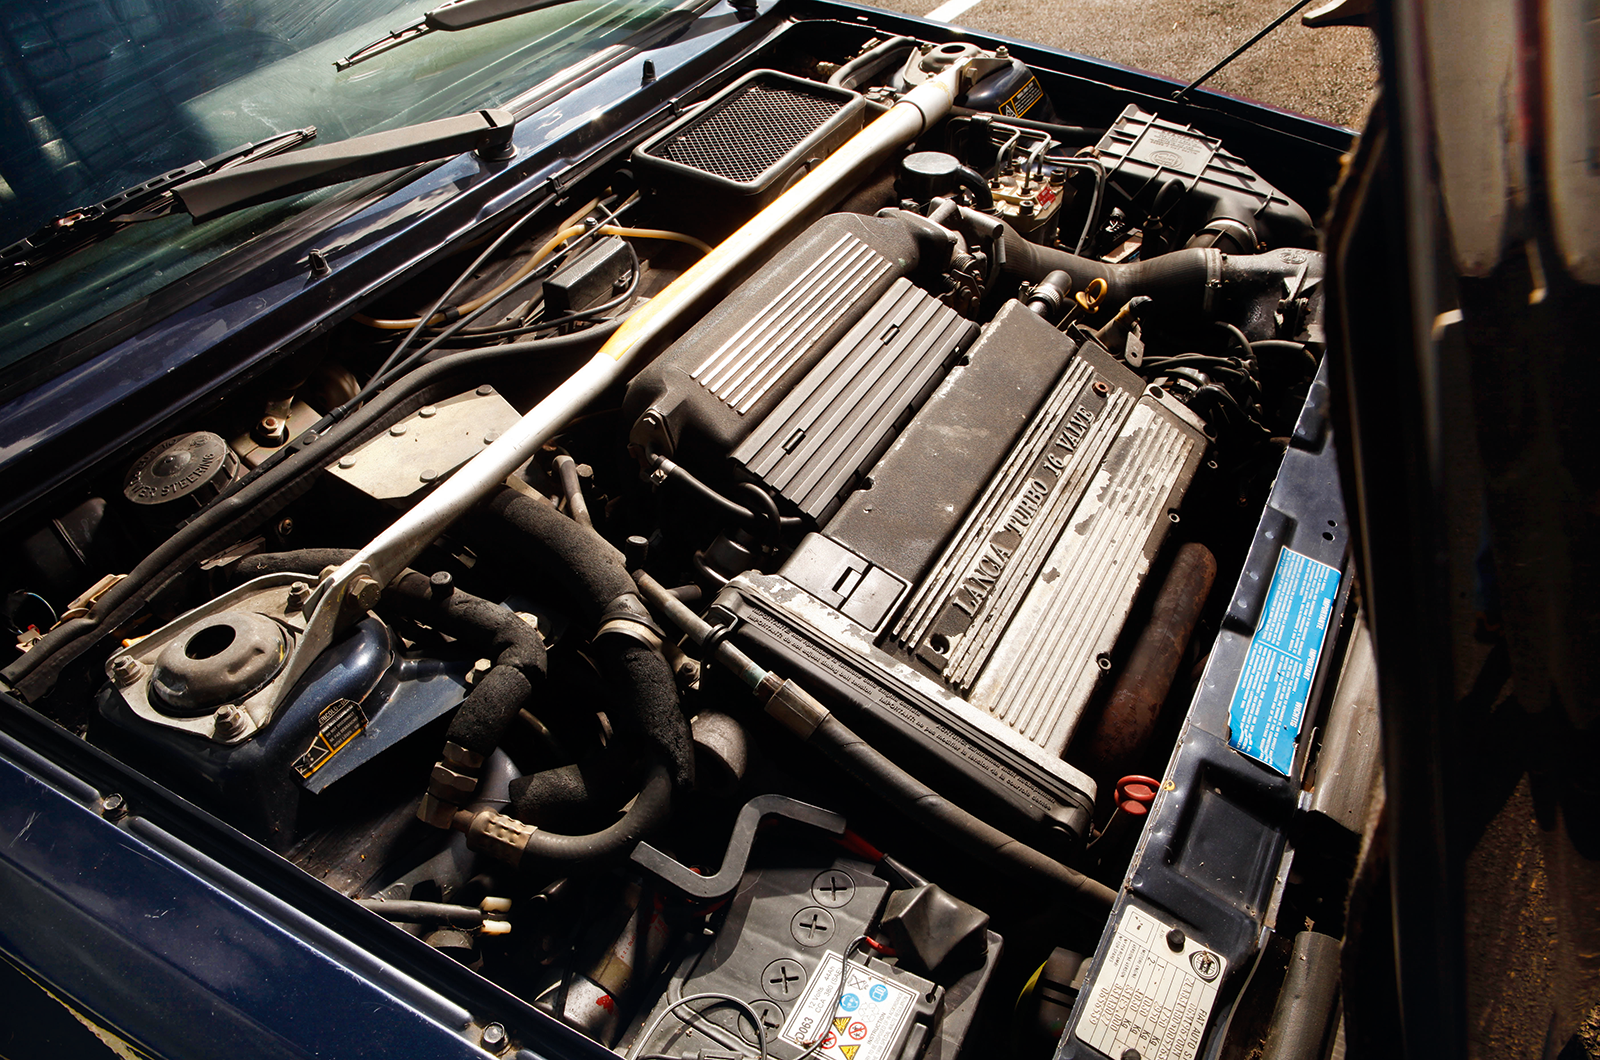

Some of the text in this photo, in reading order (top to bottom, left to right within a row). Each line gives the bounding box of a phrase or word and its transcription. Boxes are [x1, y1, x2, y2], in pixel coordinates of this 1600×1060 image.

[161, 453, 214, 497] STEERING
[952, 404, 1095, 617] LANCIA TURBO 16 VALVE
[1315, 596, 1330, 631] IMPORTANTE
[782, 635, 792, 644] do
[790, 641, 802, 651] not
[800, 647, 821, 663] adjust
[1302, 647, 1317, 681] IMPORTANT
[1289, 700, 1302, 728] WICHTIG
[807, 964, 835, 1009] 12 Volts 44Ah
[814, 997, 827, 1014] CCA
[829, 966, 843, 985] (SAE)
[866, 1011, 886, 1045] INSTRUCTION
[1119, 1016, 1131, 1030] Kg
[1129, 1022, 1141, 1036] Kg
[1138, 1000, 1162, 1042] 2950 Kg
[1148, 1004, 1172, 1048] 1750 Kg
[1194, 1007, 1208, 1026] FIAT
[1186, 1025, 1201, 1050] AUTO
